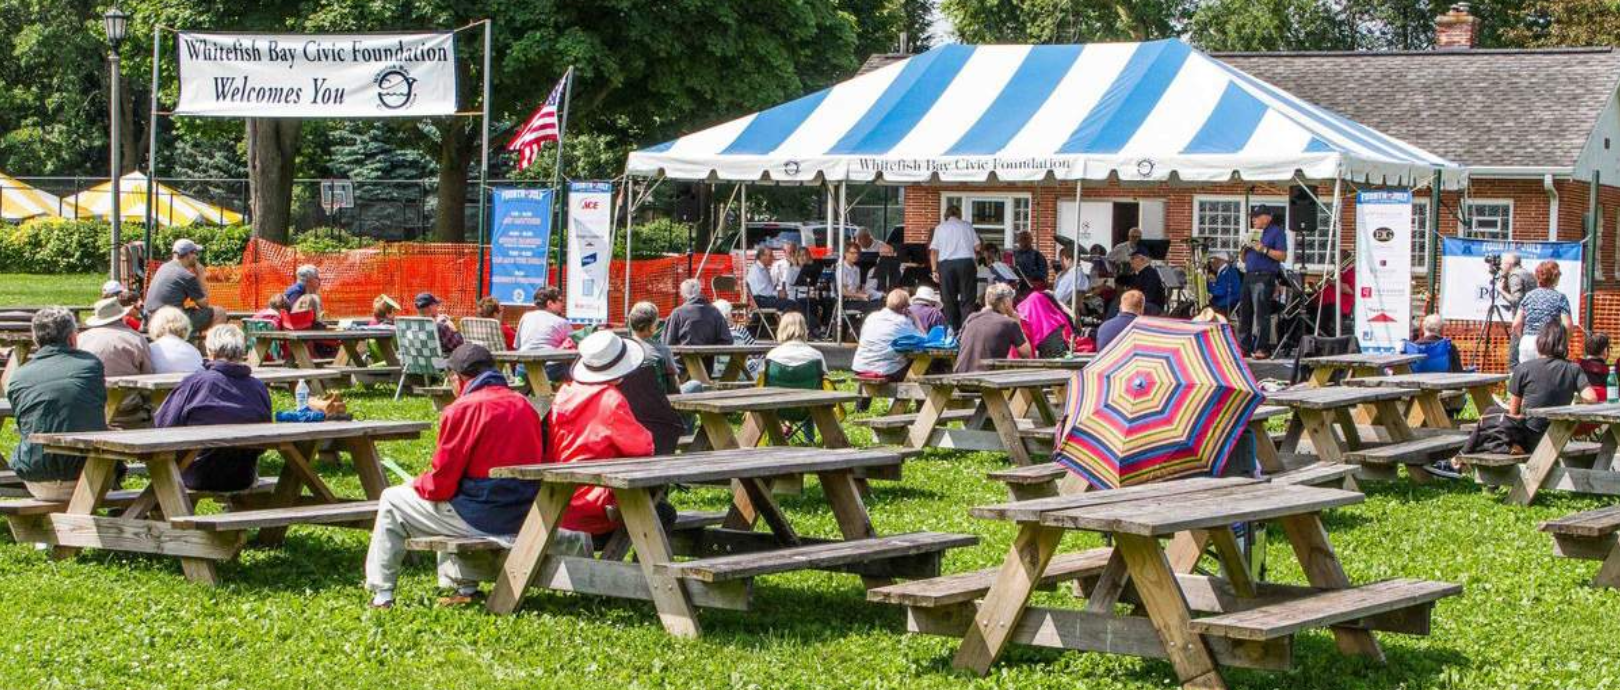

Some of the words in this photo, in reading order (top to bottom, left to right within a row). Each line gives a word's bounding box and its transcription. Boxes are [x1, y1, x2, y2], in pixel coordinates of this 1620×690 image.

[185, 39, 261, 61] Whitefish
[269, 40, 296, 69] Bay
[303, 38, 346, 62] Civic
[352, 38, 448, 62] Foundation
[213, 75, 302, 104] Welcomes
[312, 77, 346, 105] You
[859, 157, 922, 171] Whitefish
[926, 158, 951, 175] Bay
[955, 157, 989, 171] Civic
[993, 157, 1071, 171] Foundation
[581, 201, 599, 209] ACE
